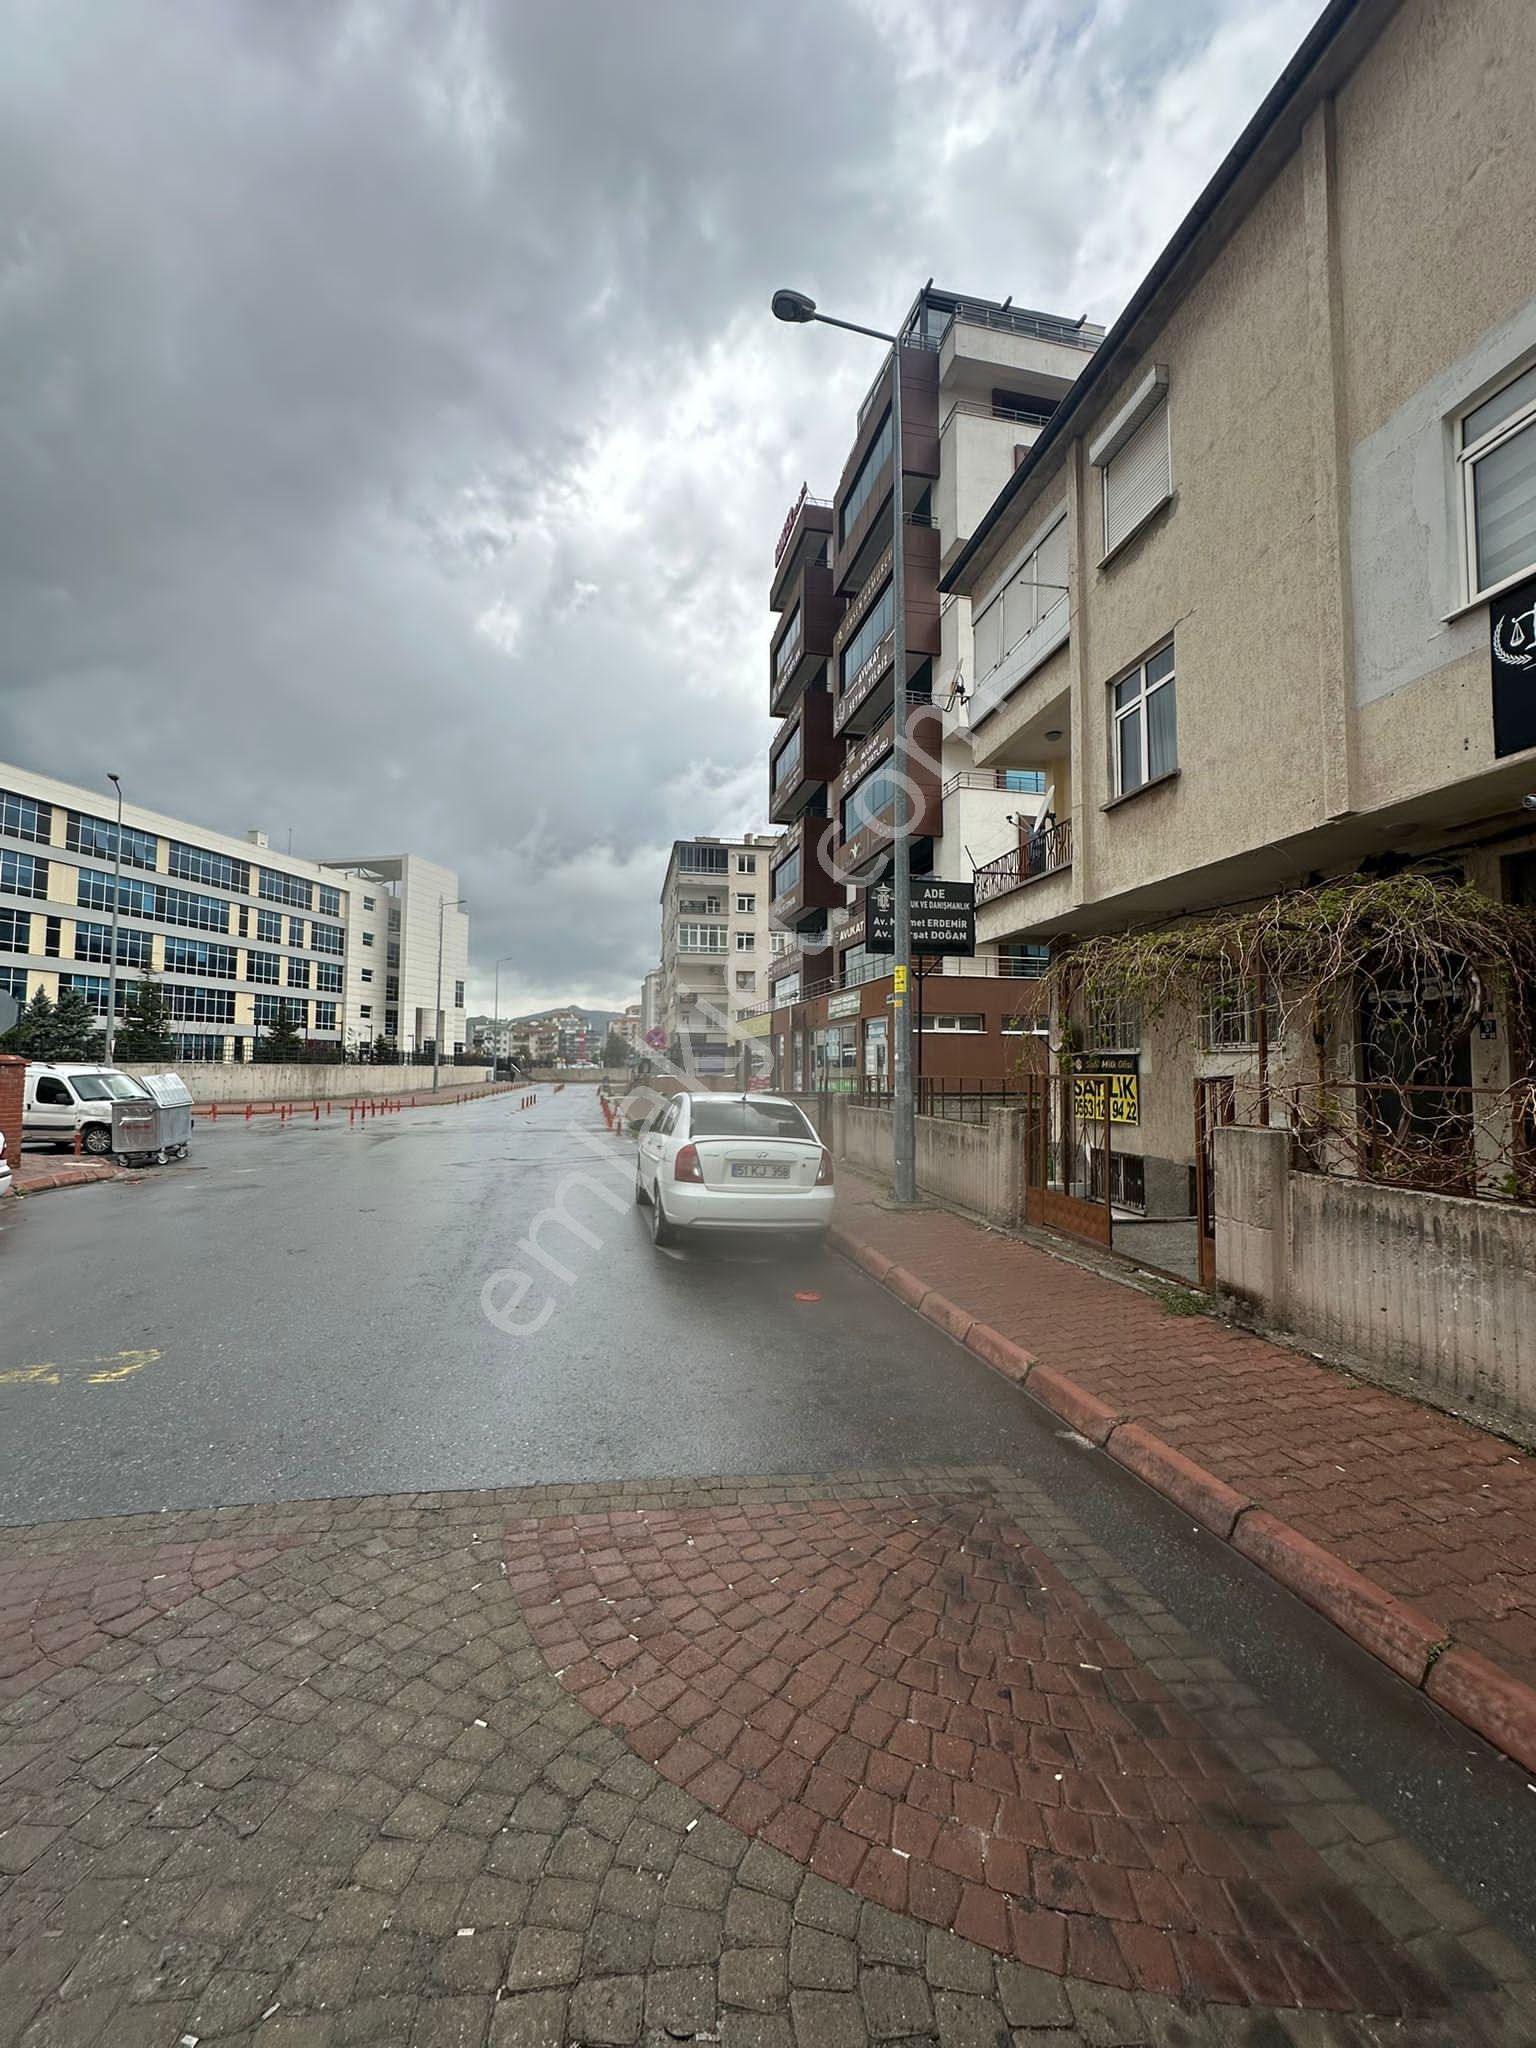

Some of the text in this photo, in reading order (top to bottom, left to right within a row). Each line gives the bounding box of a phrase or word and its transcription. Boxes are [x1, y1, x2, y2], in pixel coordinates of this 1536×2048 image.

[858, 645, 881, 684] AVUKAT
[924, 888, 945, 899] ADE
[921, 901, 928, 909] VE
[929, 901, 971, 911] DANIŞMANLIK
[873, 916, 888, 926] Av.
[927, 918, 968, 928] ERDEMİR
[840, 920, 865, 941] AVUKAT
[874, 929, 892, 938] Av.
[931, 929, 967, 940] DOĞAN
